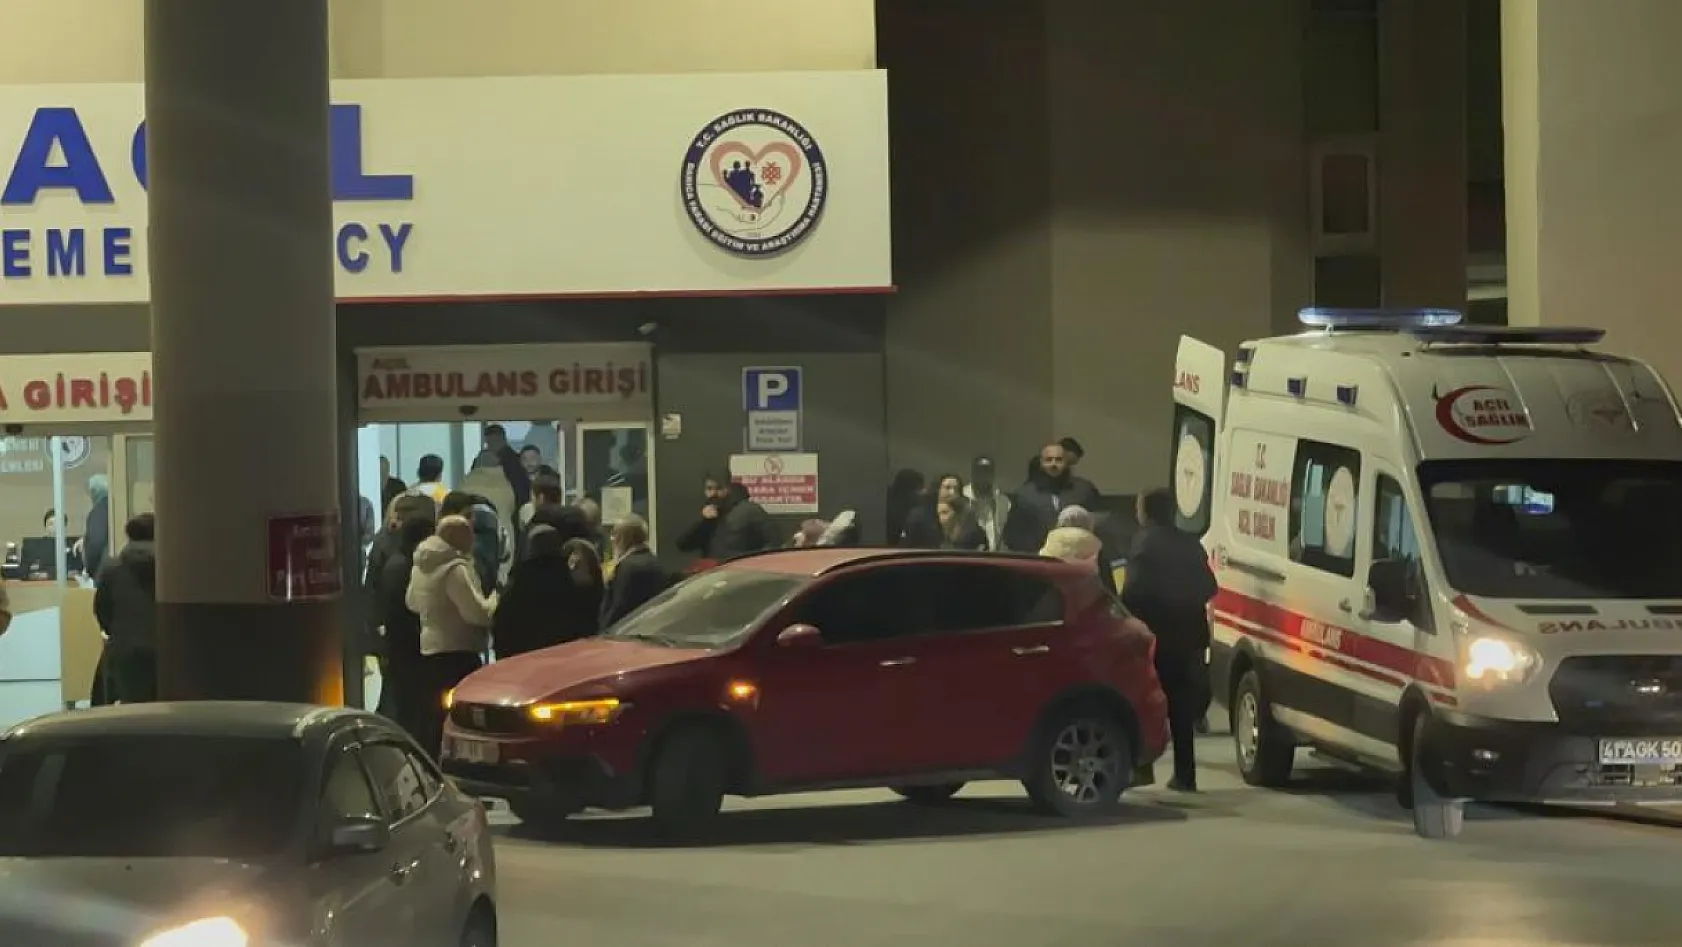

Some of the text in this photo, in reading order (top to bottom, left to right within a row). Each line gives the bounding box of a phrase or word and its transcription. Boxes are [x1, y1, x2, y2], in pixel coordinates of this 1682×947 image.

[1, 105, 414, 204] AL
[2, 222, 413, 277] EMECY
[23, 370, 150, 414] GİRİŞİ
[362, 361, 647, 399] AMBULANS GİRİŞİ
[757, 373, 788, 408] P
